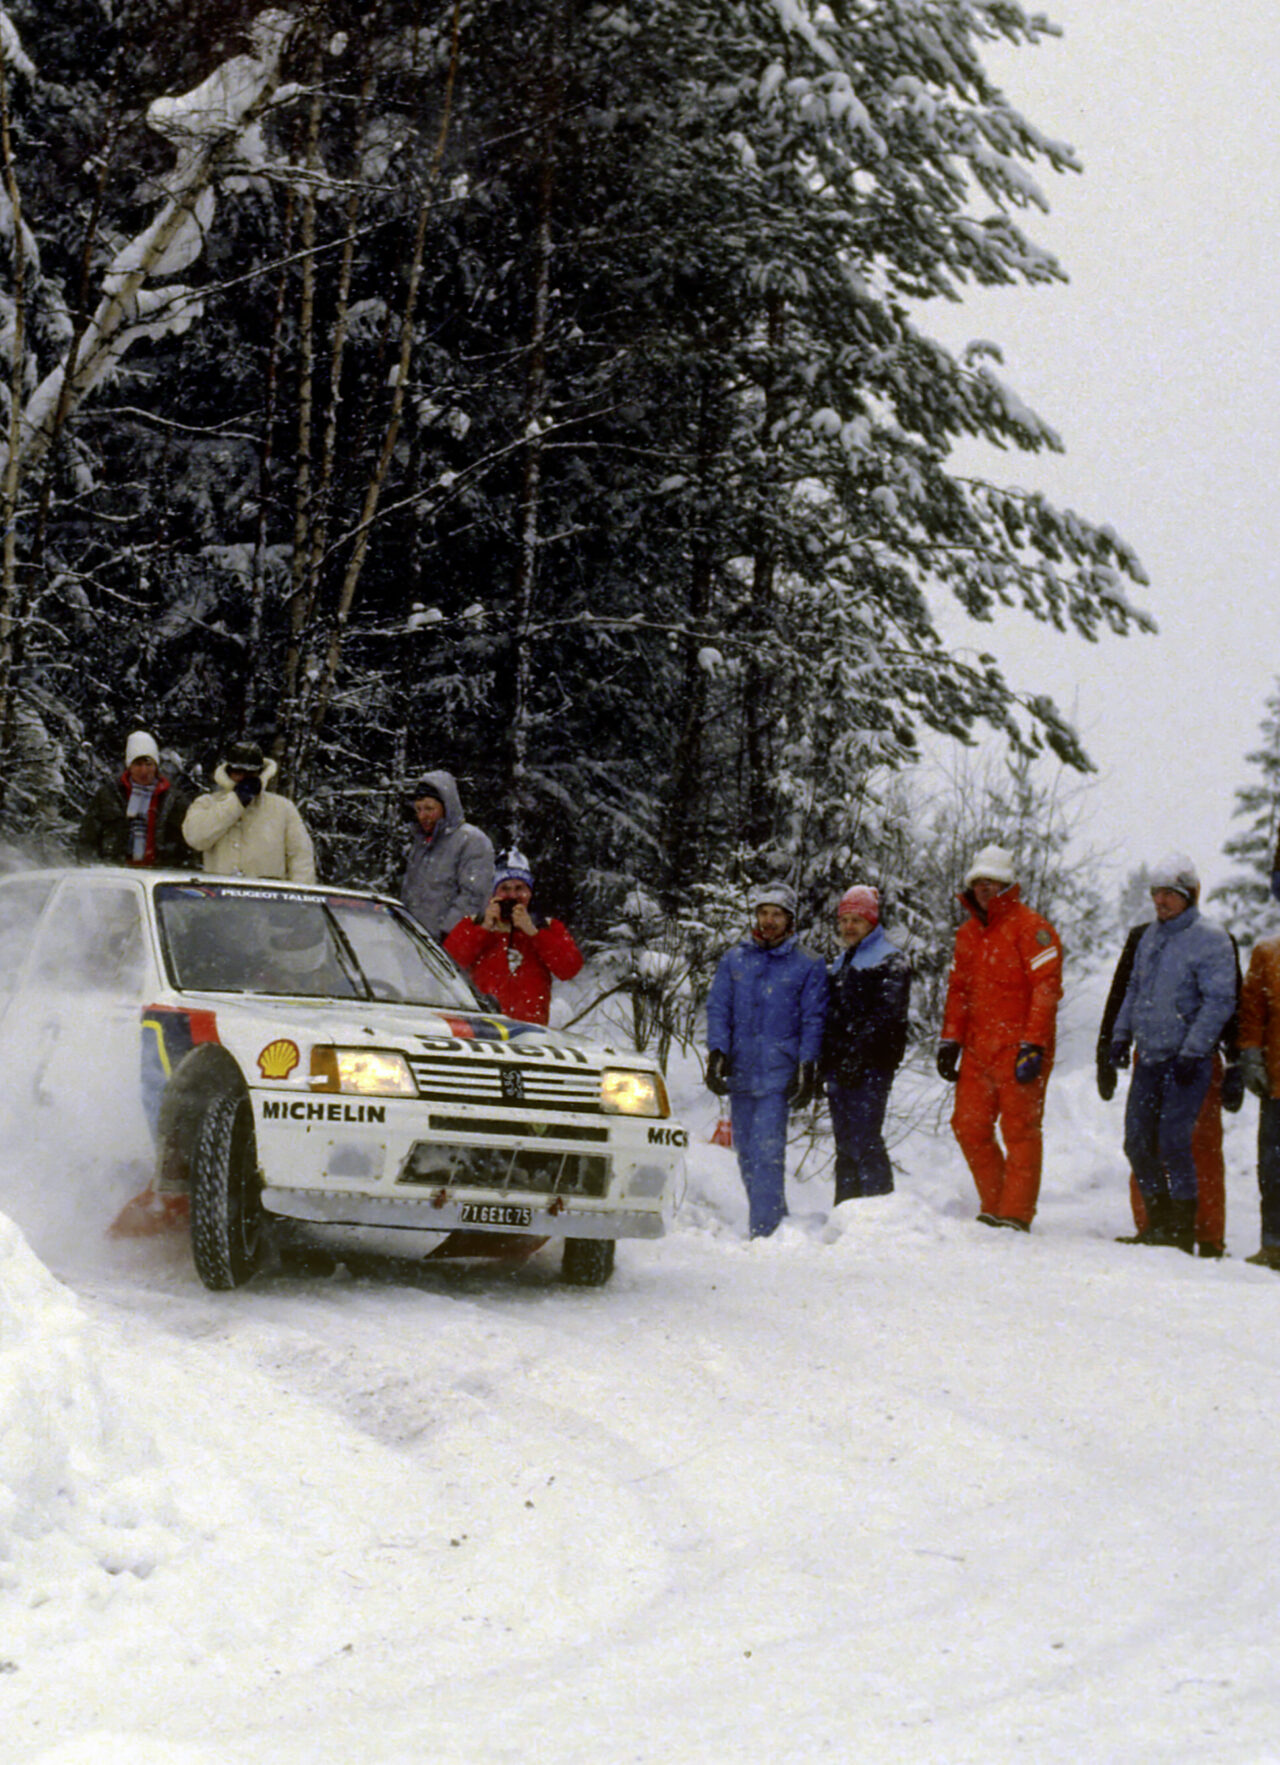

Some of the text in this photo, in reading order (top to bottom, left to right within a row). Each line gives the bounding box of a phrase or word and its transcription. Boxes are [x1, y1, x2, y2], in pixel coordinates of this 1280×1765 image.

[221, 888, 279, 900] PEUGEOT
[281, 892, 327, 904] TALBOT
[262, 1100, 386, 1123] MICHELIN
